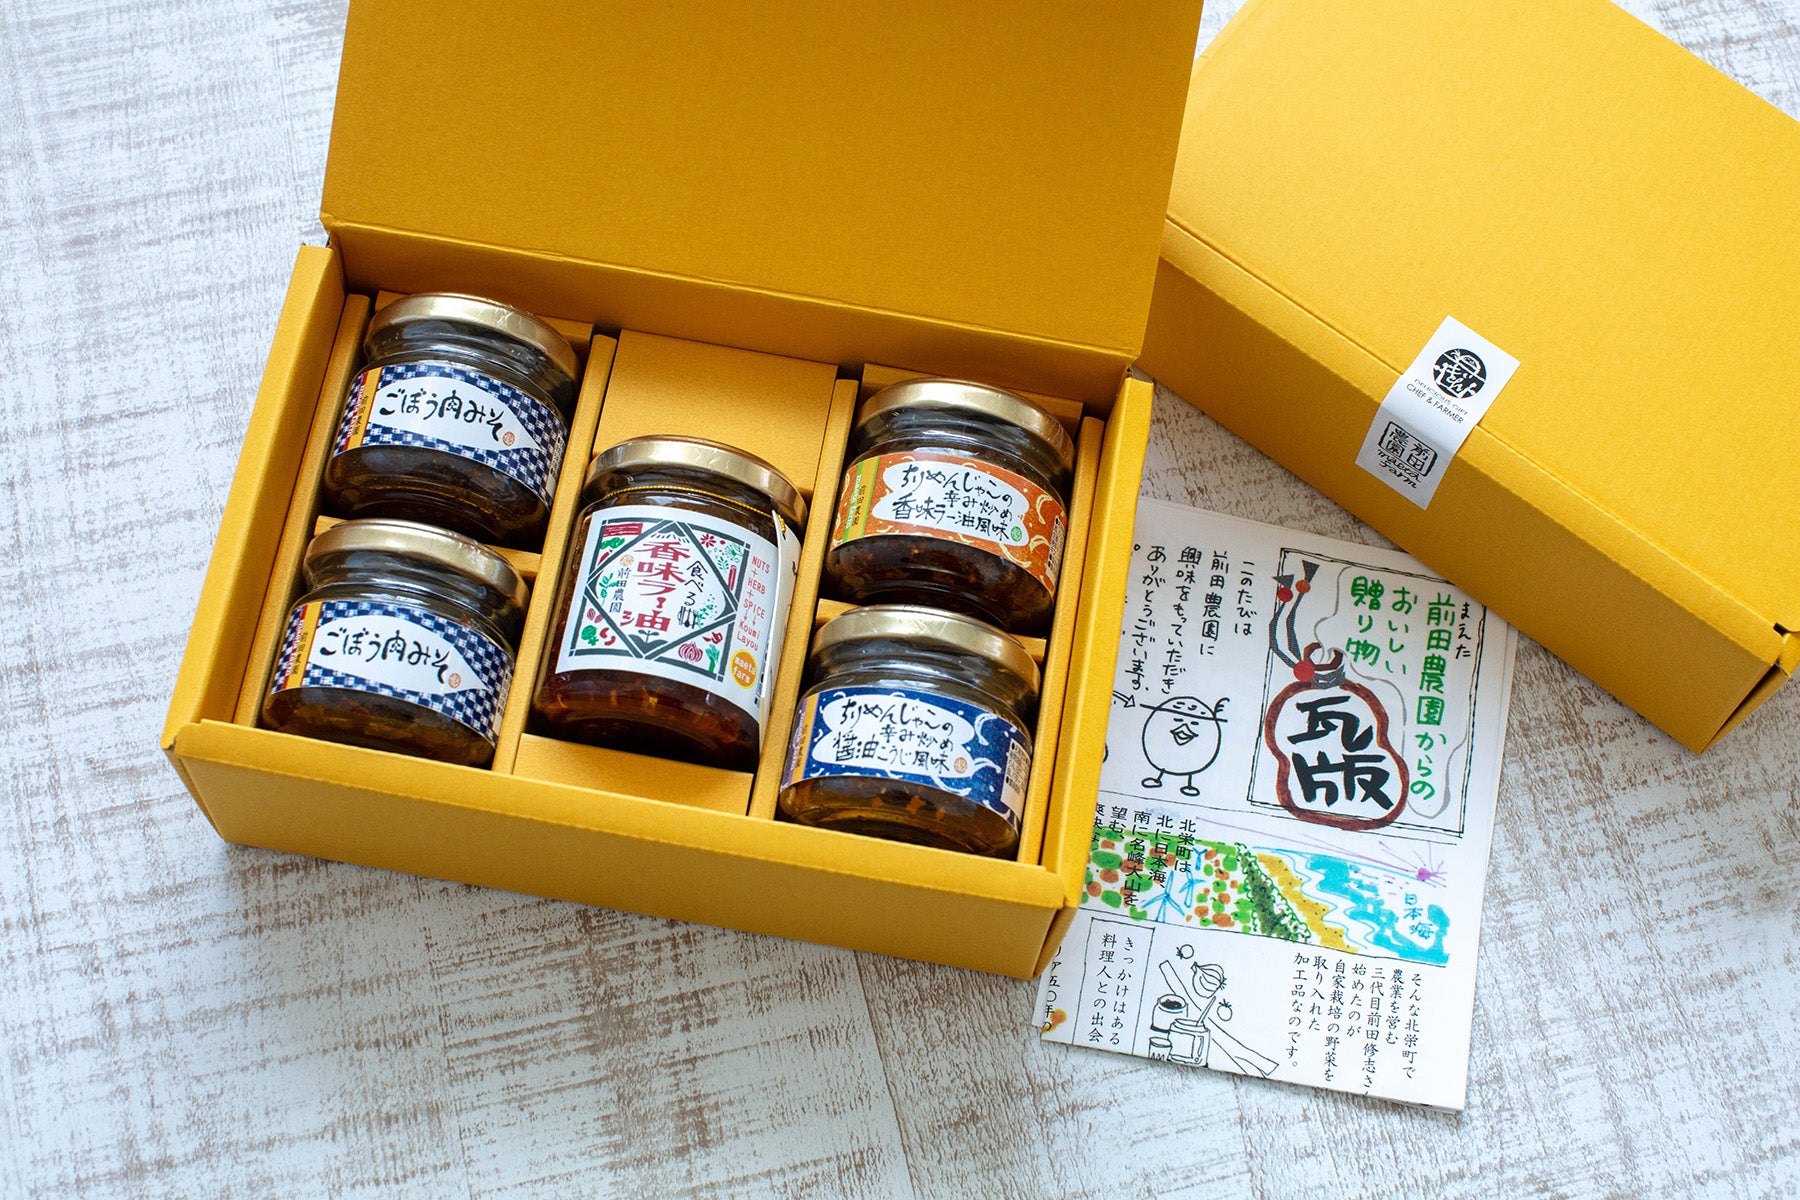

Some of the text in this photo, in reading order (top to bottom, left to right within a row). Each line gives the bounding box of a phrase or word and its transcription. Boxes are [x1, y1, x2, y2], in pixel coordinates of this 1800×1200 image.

[379, 387, 505, 442] ごぼう肉みそ
[1406, 383, 1427, 400] CHEF
[1433, 399, 1464, 424] FARMER
[901, 463, 1013, 508] ちりめんじゃこの
[943, 489, 1013, 523] 辛み炒め
[892, 492, 1011, 542] 香味ラー油風味
[609, 567, 630, 614] 前田農園
[620, 540, 690, 633] 香味ラー油
[684, 560, 708, 607] 食べる
[747, 577, 767, 596] HERB
[752, 555, 771, 575] NUTS
[743, 598, 766, 620] SPICE
[1161, 546, 1202, 695] 興味をもっていただき
[1199, 550, 1229, 656] 前田農園に
[1233, 561, 1258, 636] このたびは
[1345, 575, 1384, 667] 贈り物
[319, 627, 451, 685] ごぼう肉みそ
[737, 632, 759, 652] Layou
[739, 619, 761, 640] Koumi
[1385, 586, 1418, 675] おいしい
[1455, 602, 1472, 660] まえた
[733, 665, 751, 685] farm
[1410, 592, 1456, 801] 前田農園からの
[839, 698, 955, 736] ちりめんじゃこの
[880, 723, 955, 753] 辛み炒め
[832, 730, 951, 775] 醤油こうじ風味
[1287, 695, 1394, 811] 瓦版
[1108, 805, 1128, 840] 望む、
[1148, 814, 1174, 889] 北に日本海、
[1175, 819, 1197, 873] 北栄町は
[1123, 810, 1152, 907] 南に名峰大山を
[1403, 892, 1435, 940] 日本海
[1088, 933, 1117, 1042] 料理人との出会
[1109, 936, 1135, 1045] きっかけはある
[1285, 952, 1310, 1067] 加工品なのです。
[1308, 955, 1329, 1032] 取り入れた
[1346, 963, 1367, 1037] 始めたのが
[1385, 968, 1405, 1045] 農業を営む
[1324, 959, 1347, 1082] 自家栽培の野菜を
[1361, 967, 1386, 1096] 三代目前田修志さ
[1402, 973, 1423, 1079] そんな北栄町で
